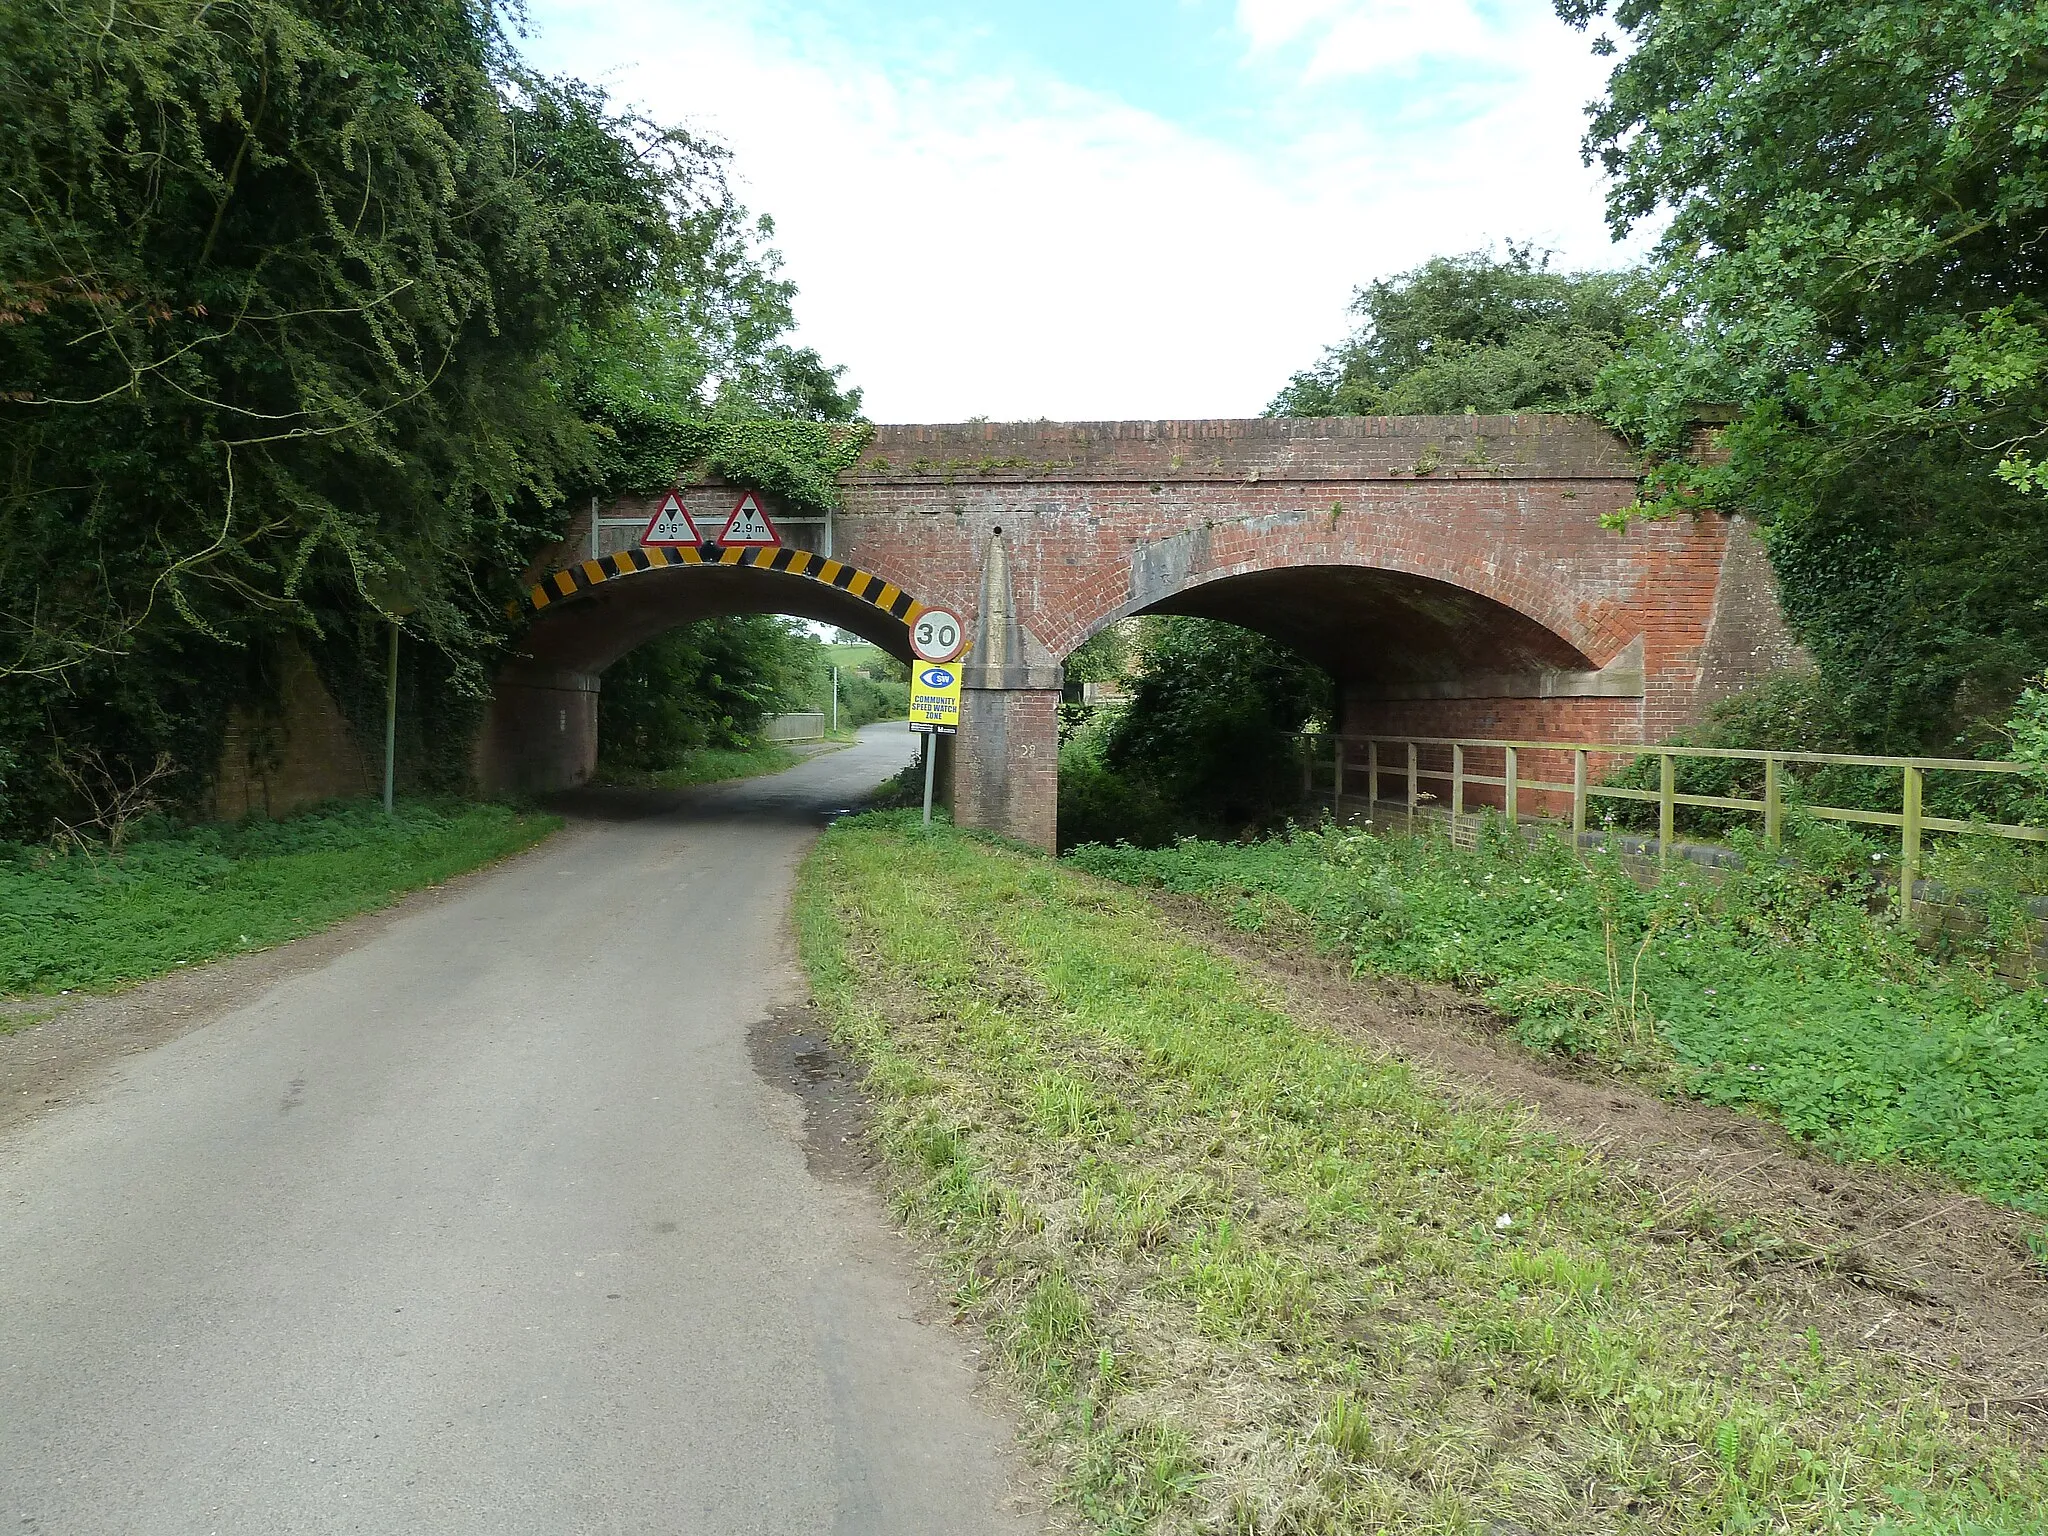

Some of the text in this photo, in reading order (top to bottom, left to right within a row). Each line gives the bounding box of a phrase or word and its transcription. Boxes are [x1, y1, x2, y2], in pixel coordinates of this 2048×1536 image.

[732, 522, 765, 533] 2.9 m
[916, 623, 956, 647] 30
[914, 695, 956, 705] COMMUNITY
[911, 703, 957, 713] SPEED WATCH
[925, 711, 943, 720] ZONE
